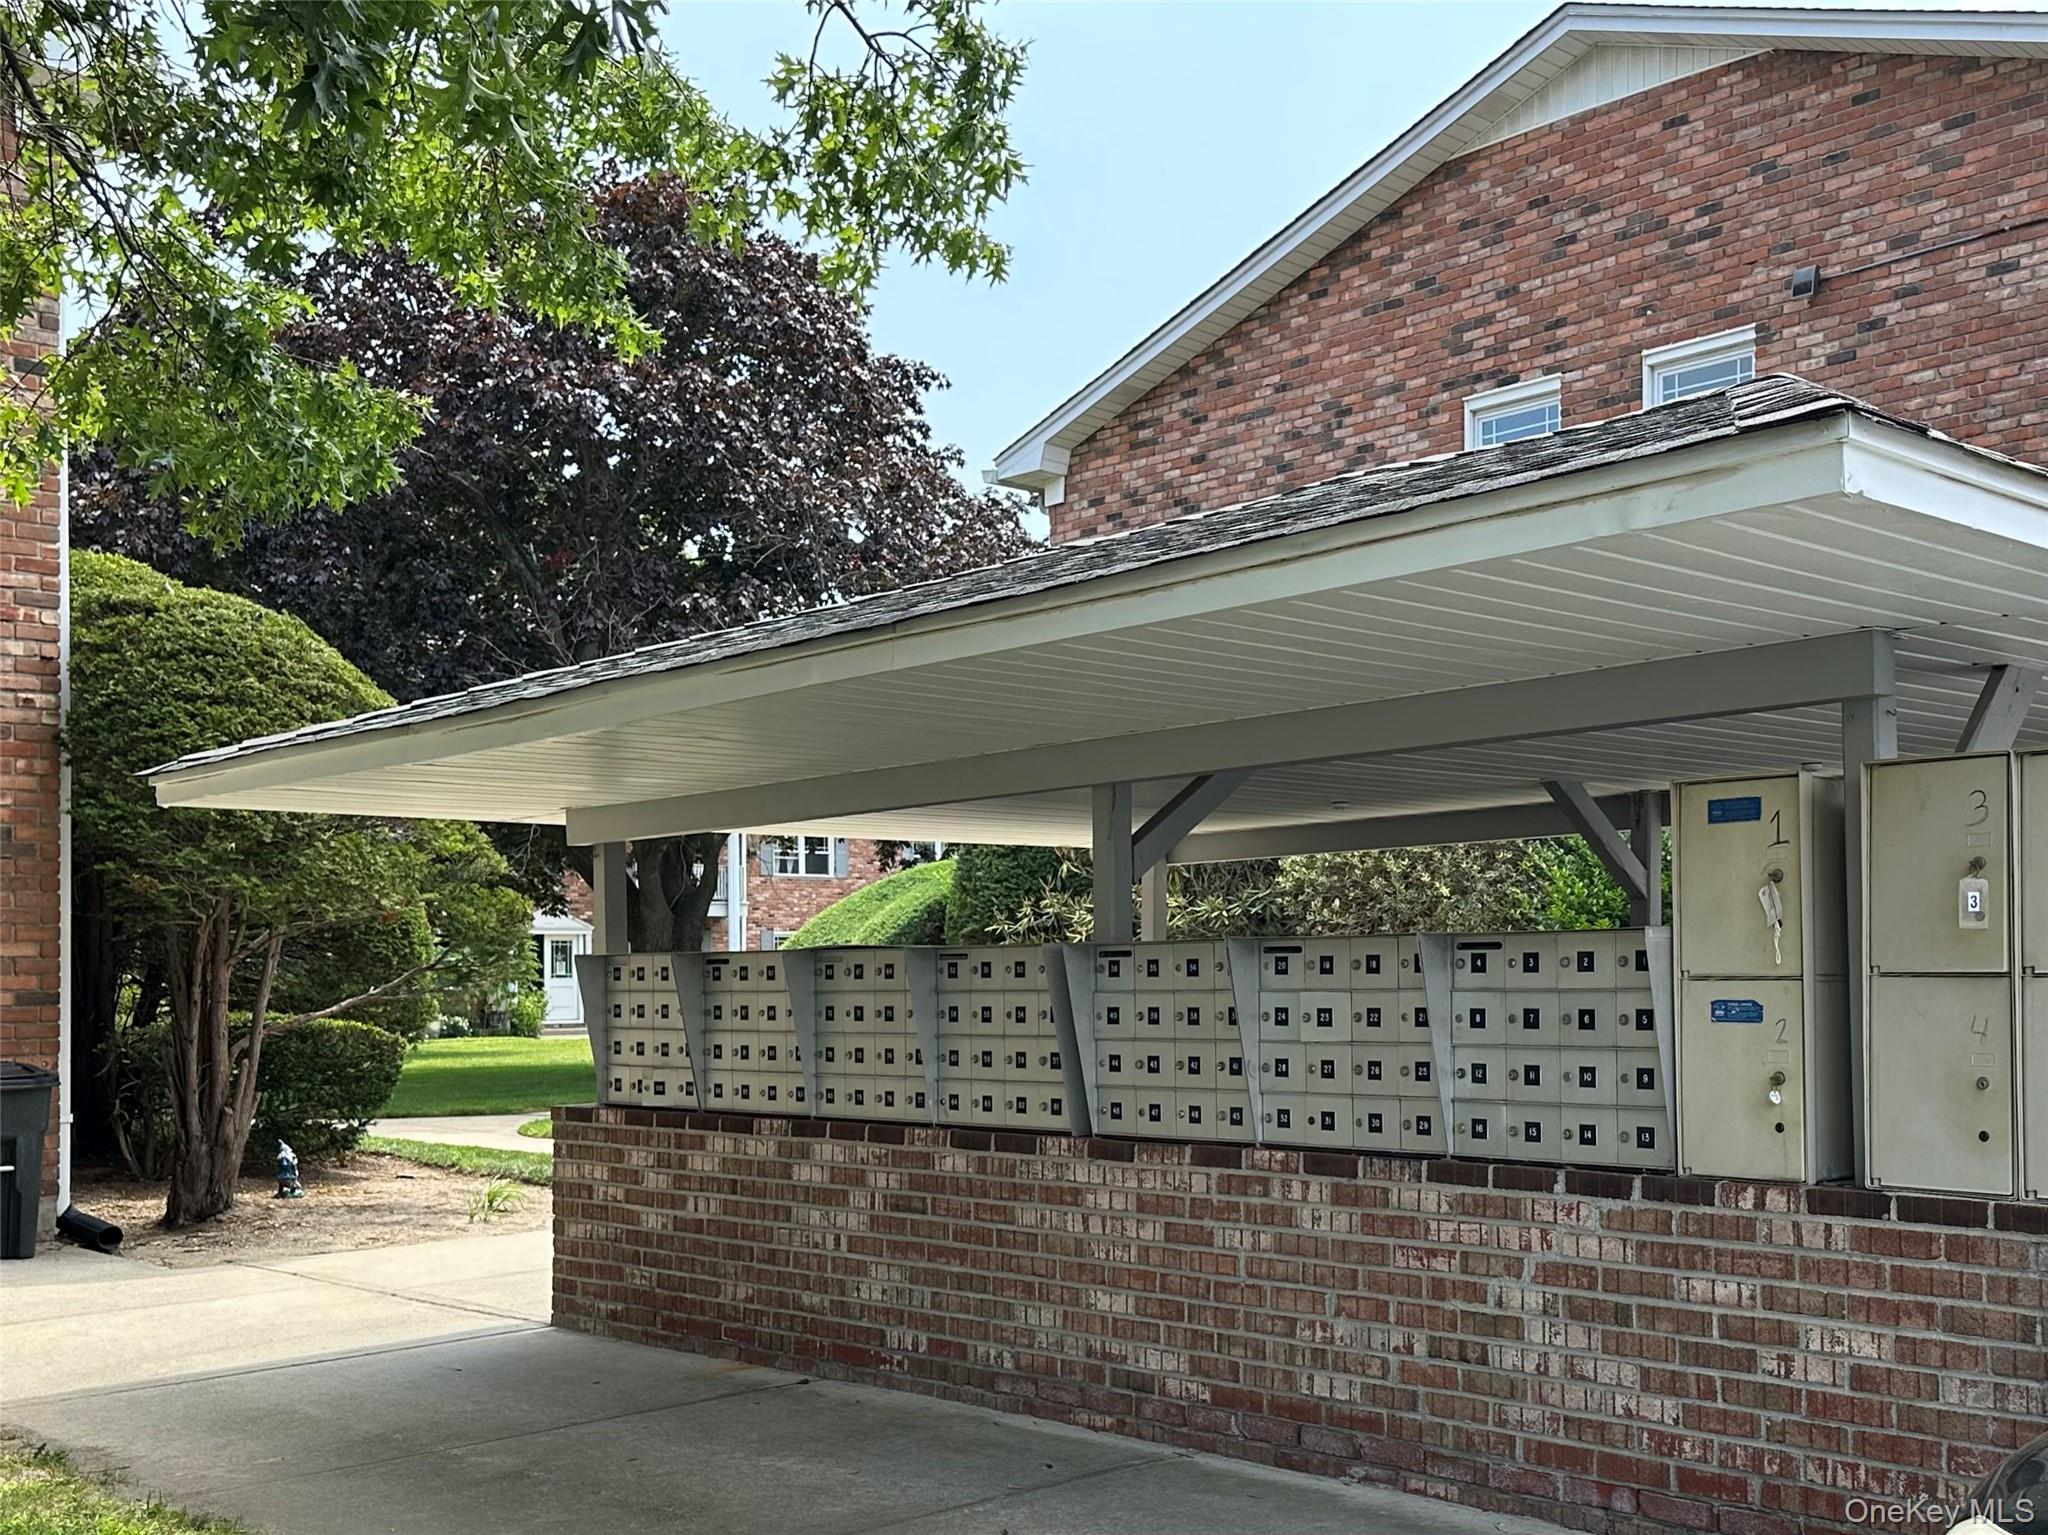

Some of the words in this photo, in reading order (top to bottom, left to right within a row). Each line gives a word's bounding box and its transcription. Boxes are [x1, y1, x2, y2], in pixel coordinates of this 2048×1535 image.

[1965, 790, 1990, 827] 3
[1768, 810, 1790, 848] 1
[1970, 895, 1978, 908] 3
[1476, 958, 1482, 966] 4
[1528, 958, 1534, 966] 3
[1584, 958, 1588, 966] 2
[1476, 1014, 1480, 1022] 8
[1530, 1014, 1534, 1022] 7
[1584, 1014, 1590, 1024] 6
[1642, 1014, 1648, 1024] 5
[1775, 1018, 1788, 1044] 2
[1970, 1014, 1988, 1046] 4
[1476, 1070, 1482, 1078] 12
[1530, 1072, 1534, 1080] 11
[1584, 1072, 1592, 1082] 10
[1642, 1074, 1648, 1082] 9
[1476, 1124, 1484, 1132] 16
[1530, 1128, 1536, 1136] 15
[1584, 1130, 1592, 1138] 14
[1642, 1132, 1650, 1142] 13
